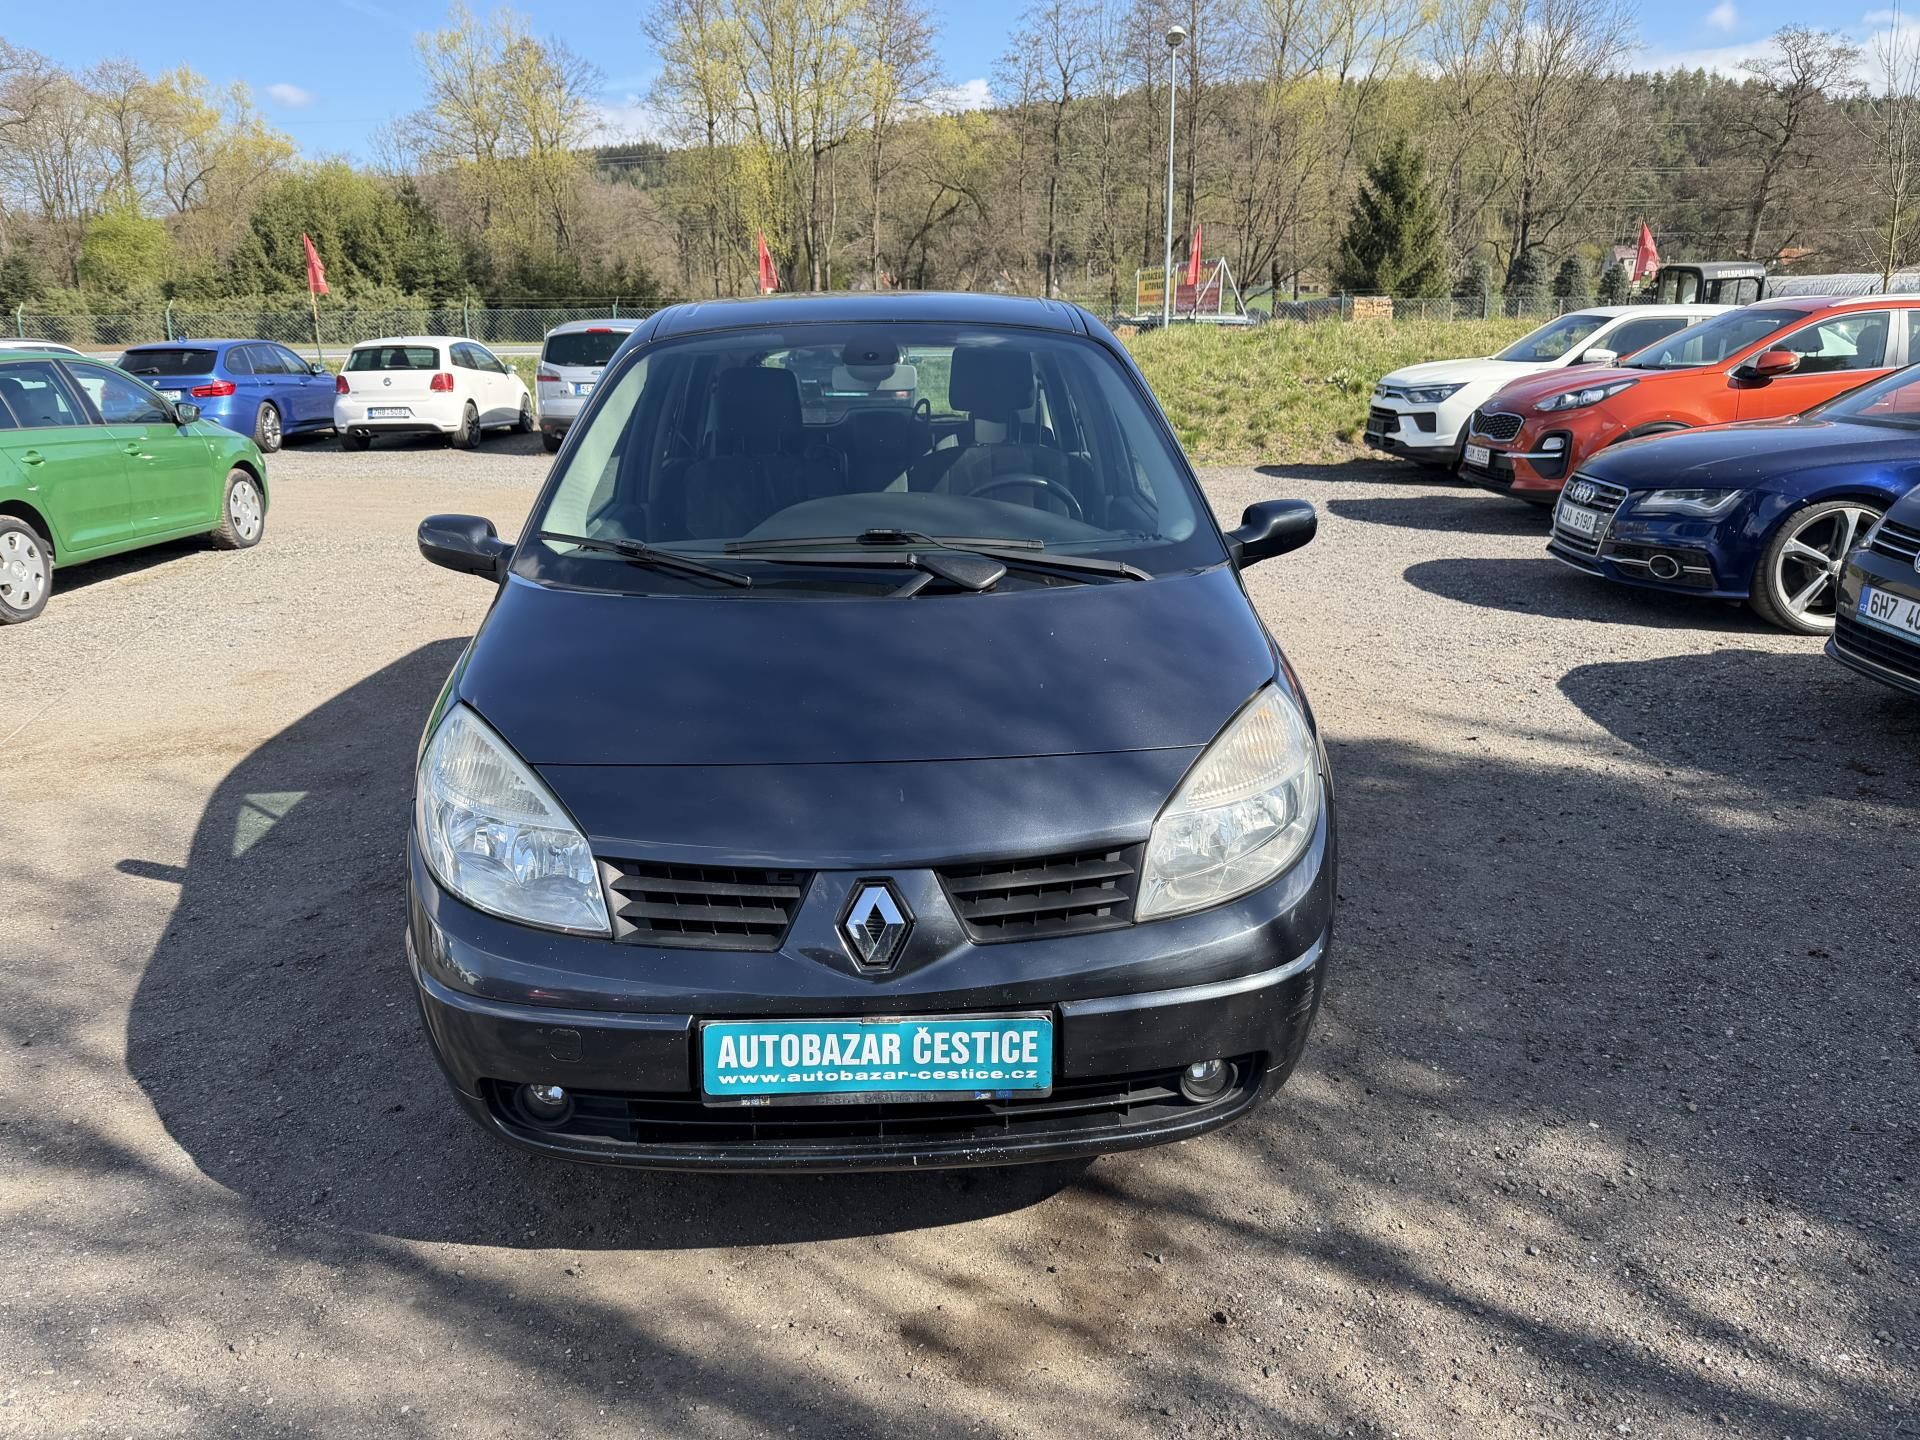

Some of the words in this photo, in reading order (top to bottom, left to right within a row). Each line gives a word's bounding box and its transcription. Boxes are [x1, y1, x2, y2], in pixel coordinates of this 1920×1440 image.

[1717, 269, 1755, 278] CATERPILLAR
[1574, 511, 1593, 530] 6190
[1870, 592, 1899, 620] 6H7
[716, 1033, 901, 1069] AUTOBAZAR
[913, 1026, 1038, 1066] ČESTICE
[718, 1068, 1038, 1085] www.autobazar-cestice.cz
